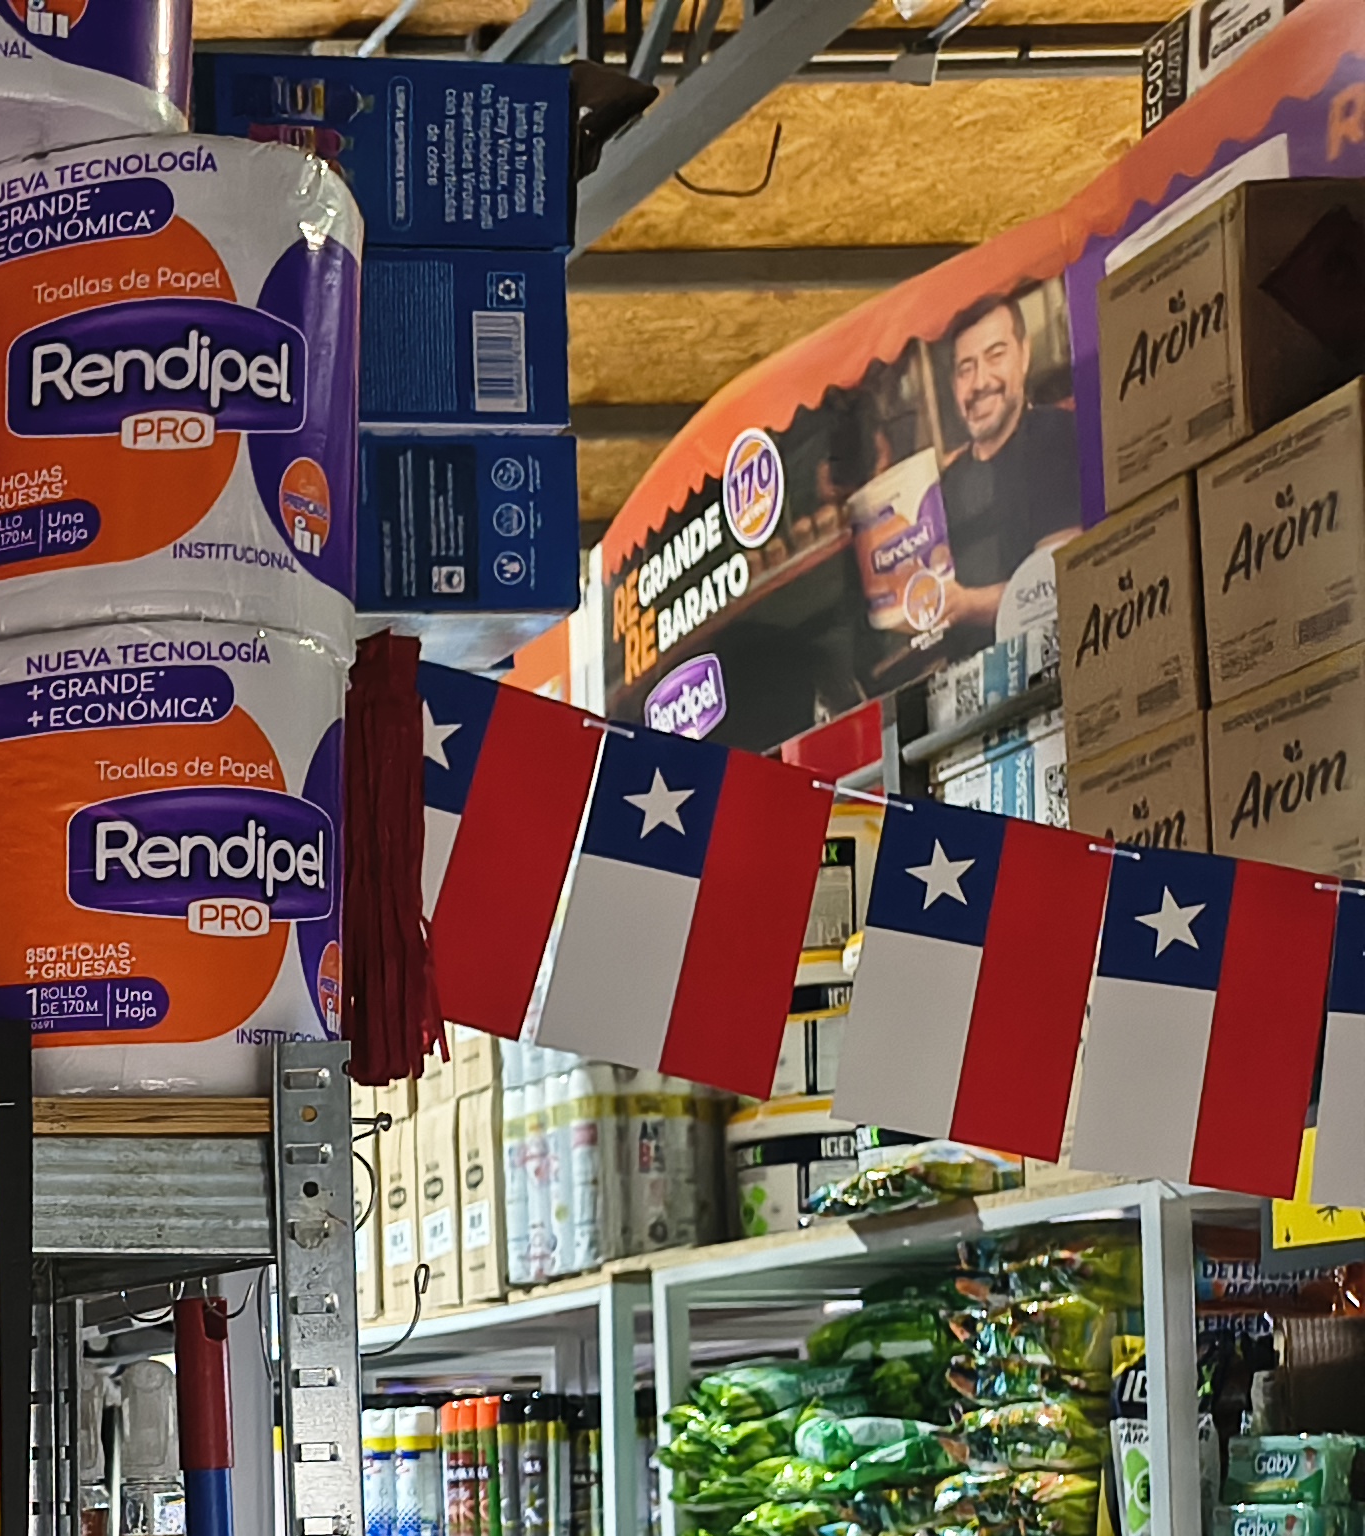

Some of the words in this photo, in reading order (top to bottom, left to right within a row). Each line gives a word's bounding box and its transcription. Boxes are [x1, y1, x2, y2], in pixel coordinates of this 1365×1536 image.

[31, 329, 291, 407] Rendipel
[133, 416, 206, 444] PRO
[730, 448, 772, 514] 170
[47, 511, 84, 528] Una
[47, 527, 88, 546] Hoja
[116, 637, 271, 667] TECNOLOGÍA
[94, 757, 178, 781] Toallas
[183, 755, 215, 777] de
[219, 756, 275, 783] Papel
[94, 819, 325, 897] Rendipel
[198, 903, 263, 931] PRO
[1254, 1450, 1297, 1478] Gaby
